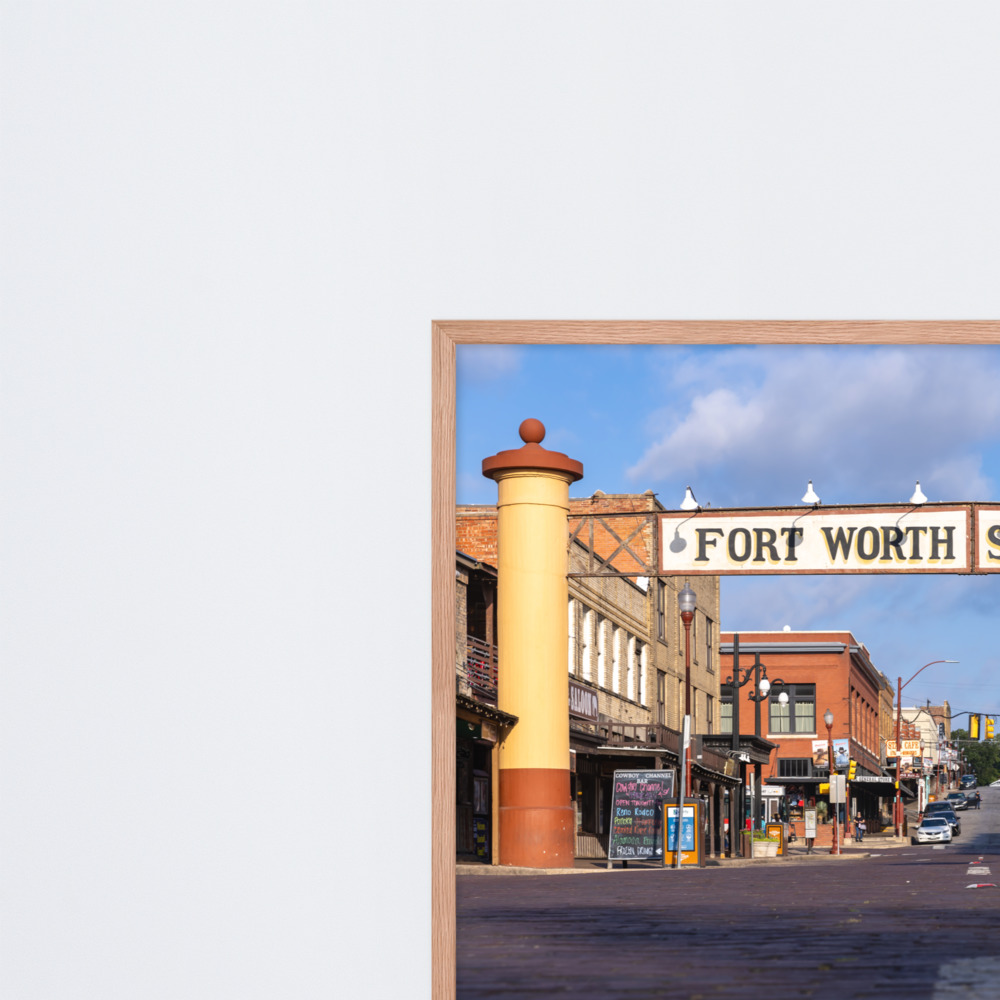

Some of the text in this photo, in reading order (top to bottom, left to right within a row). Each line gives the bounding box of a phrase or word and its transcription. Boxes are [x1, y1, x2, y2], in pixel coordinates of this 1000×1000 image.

[694, 526, 957, 563] FORT WORTH
[571, 686, 592, 716] SALOON
[904, 742, 919, 750] CAFE
[616, 807, 655, 816] Reno Rodeo
